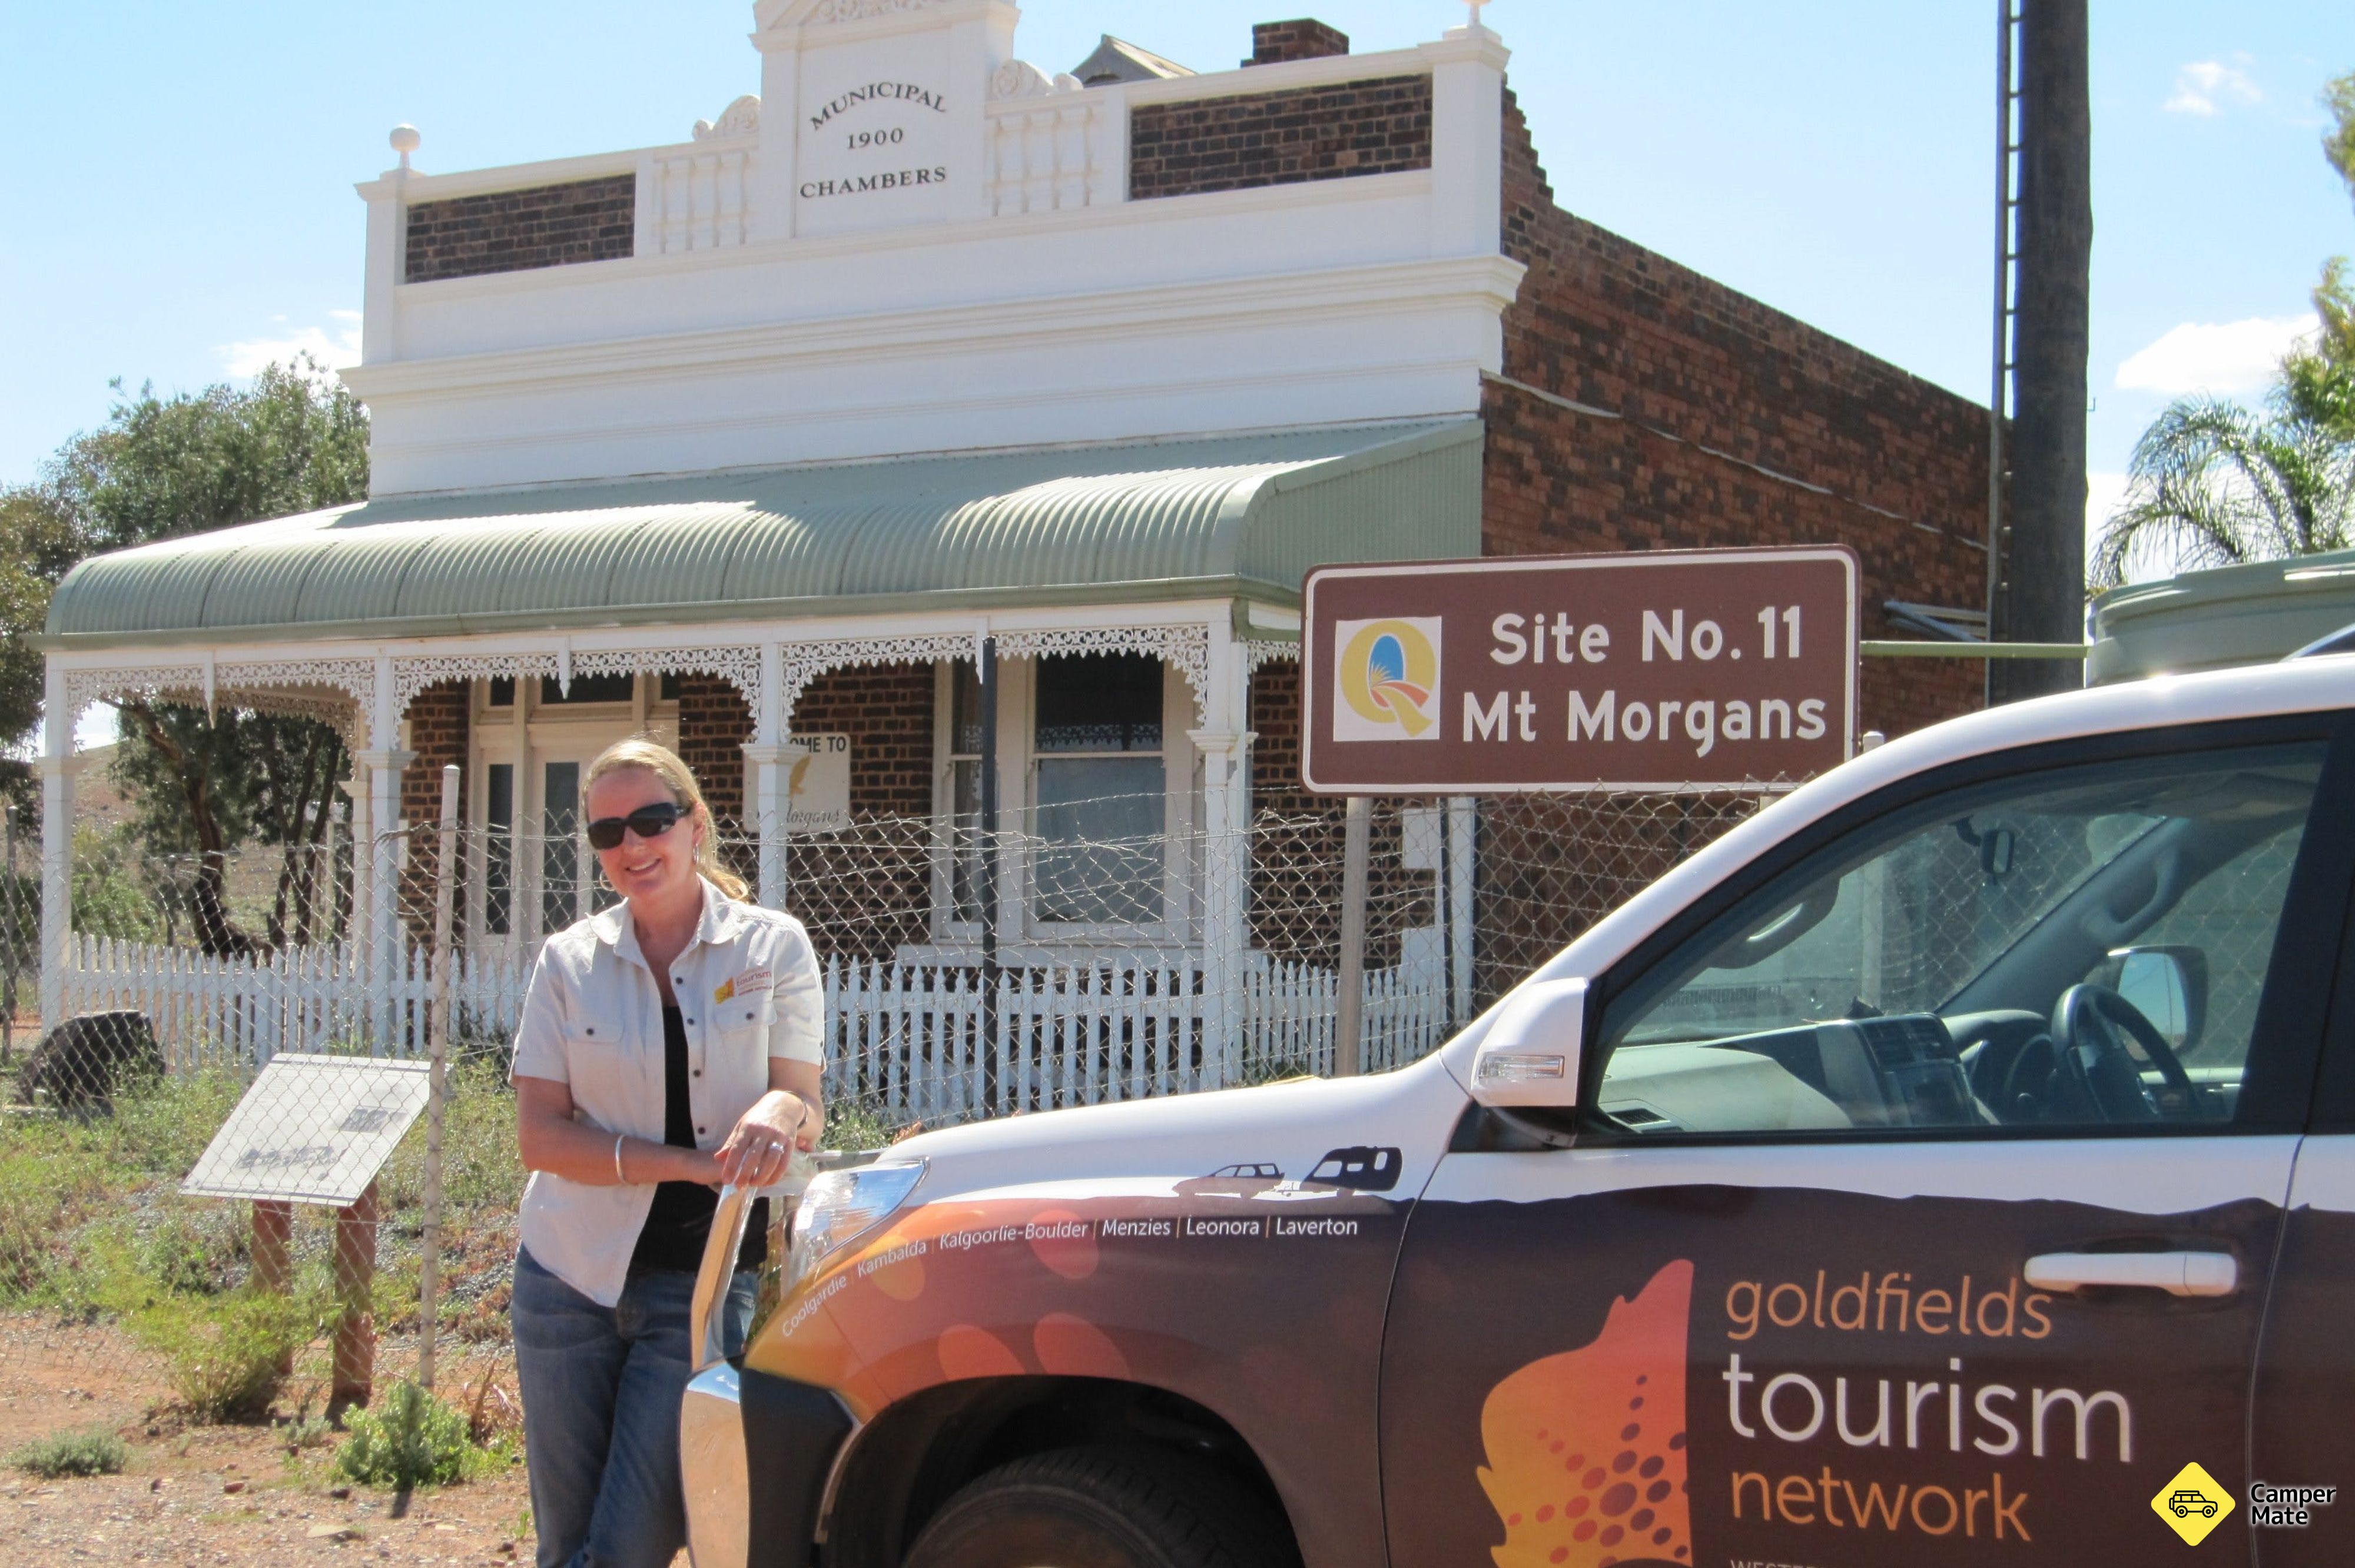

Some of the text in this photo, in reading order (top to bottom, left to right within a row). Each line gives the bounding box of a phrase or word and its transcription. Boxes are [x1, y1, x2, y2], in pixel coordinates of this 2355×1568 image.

[810, 82, 947, 130] MUNICIPAL
[847, 128, 903, 149] 1900
[800, 167, 947, 198] CHAMBERS
[1490, 605, 1801, 665] Site No. 11
[827, 736, 846, 752] TO
[1462, 690, 1826, 758] Mt Morgans
[782, 1216, 1358, 1338] Coolgardie Kambalda Kalgoorlie-Boulder Menzies Leonora Laverton
[1726, 1270, 2052, 1340] goldfields
[1722, 1354, 2131, 1462] tourism
[1732, 1466, 2032, 1542] network
